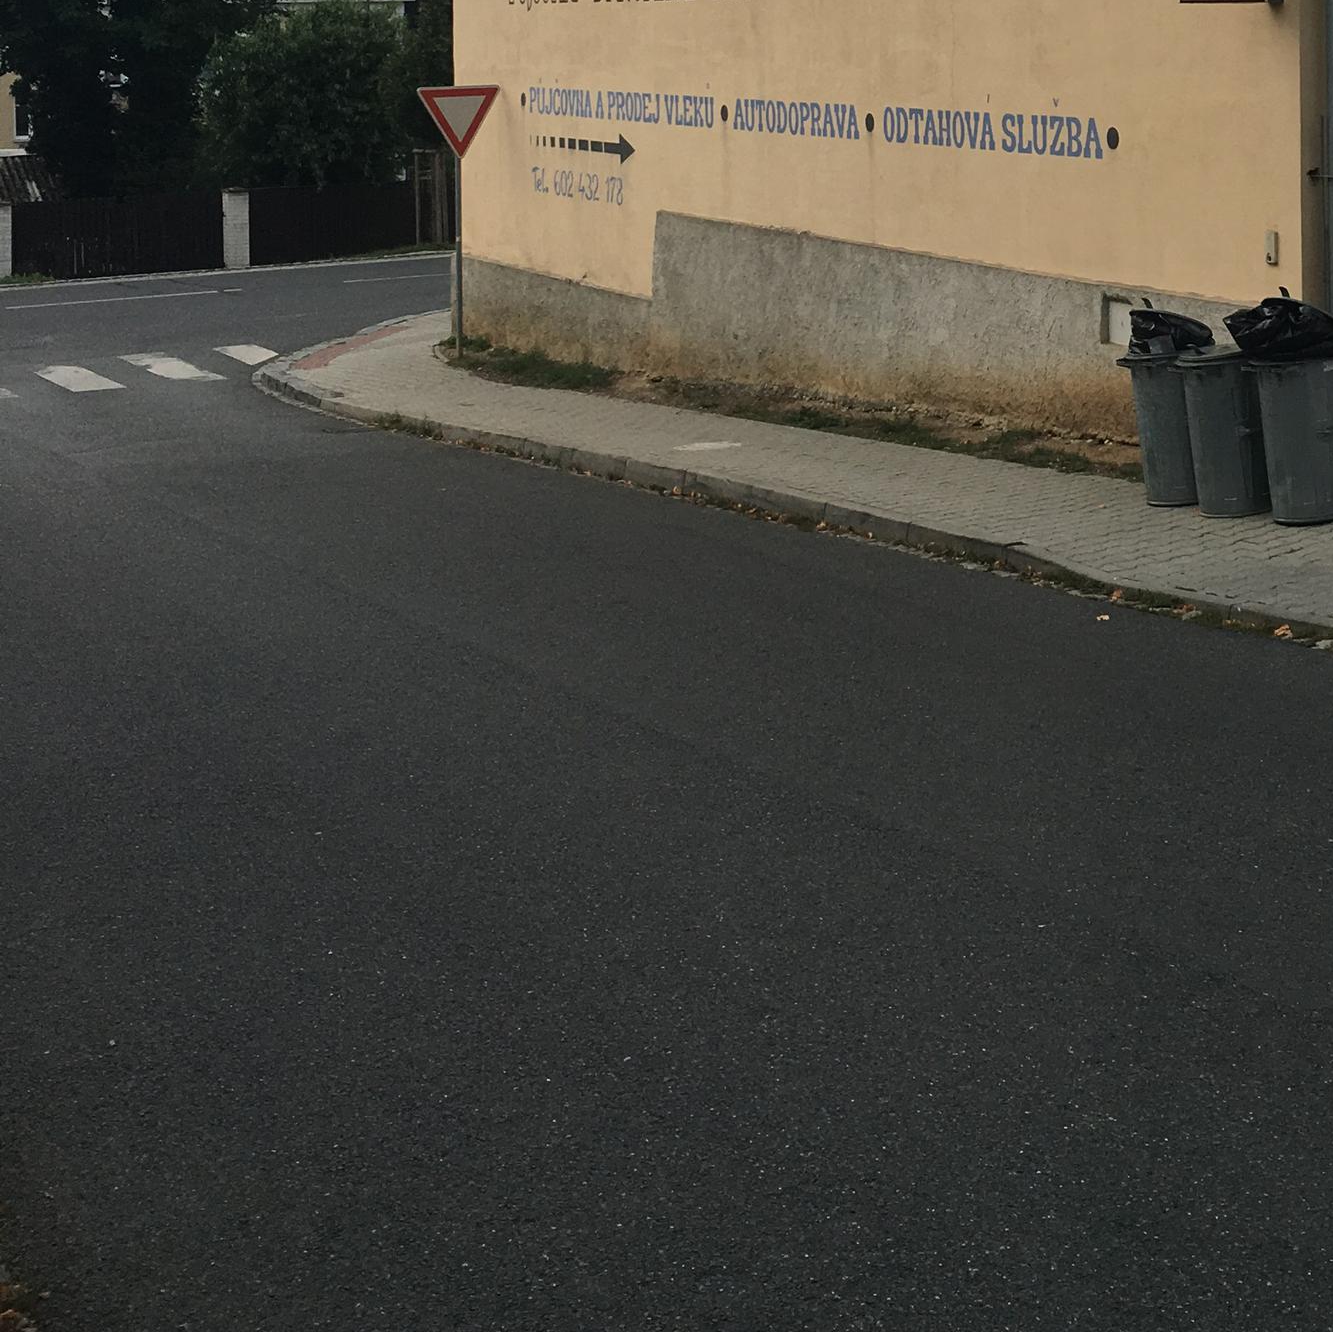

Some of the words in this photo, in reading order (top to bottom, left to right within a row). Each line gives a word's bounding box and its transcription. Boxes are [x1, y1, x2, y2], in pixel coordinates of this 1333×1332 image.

[595, 90, 604, 119] A
[607, 90, 661, 125] PRODEJ
[733, 97, 861, 140] AUTODOPRAVA
[883, 93, 996, 151] ODTAHOVÁ
[1001, 97, 1104, 160] SLUŽBA
[554, 169, 573, 198] 602
[577, 172, 600, 202] 432
[605, 175, 623, 206] 178
